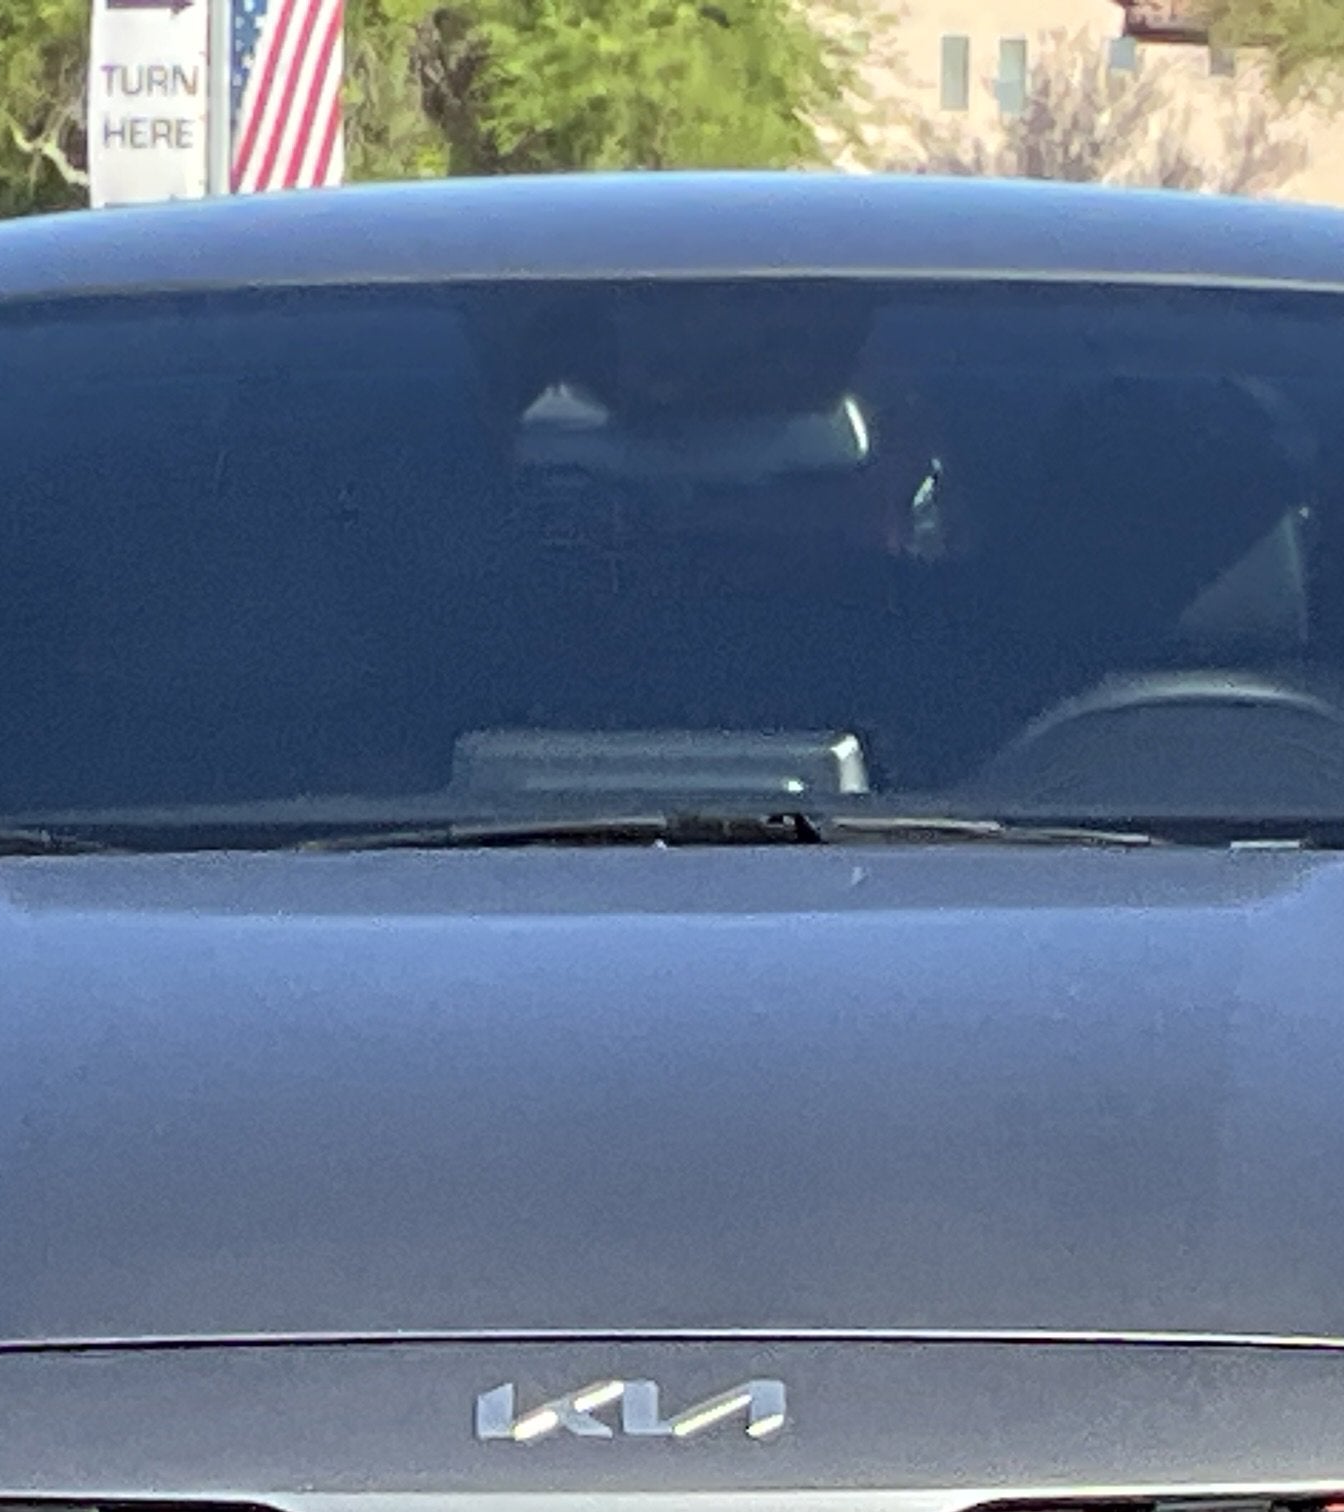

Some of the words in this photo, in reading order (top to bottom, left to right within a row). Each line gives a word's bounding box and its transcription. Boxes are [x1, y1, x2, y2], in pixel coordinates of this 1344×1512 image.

[101, 64, 199, 97] TURN
[102, 117, 194, 149] HERE
[475, 1379, 786, 1440] KIA
